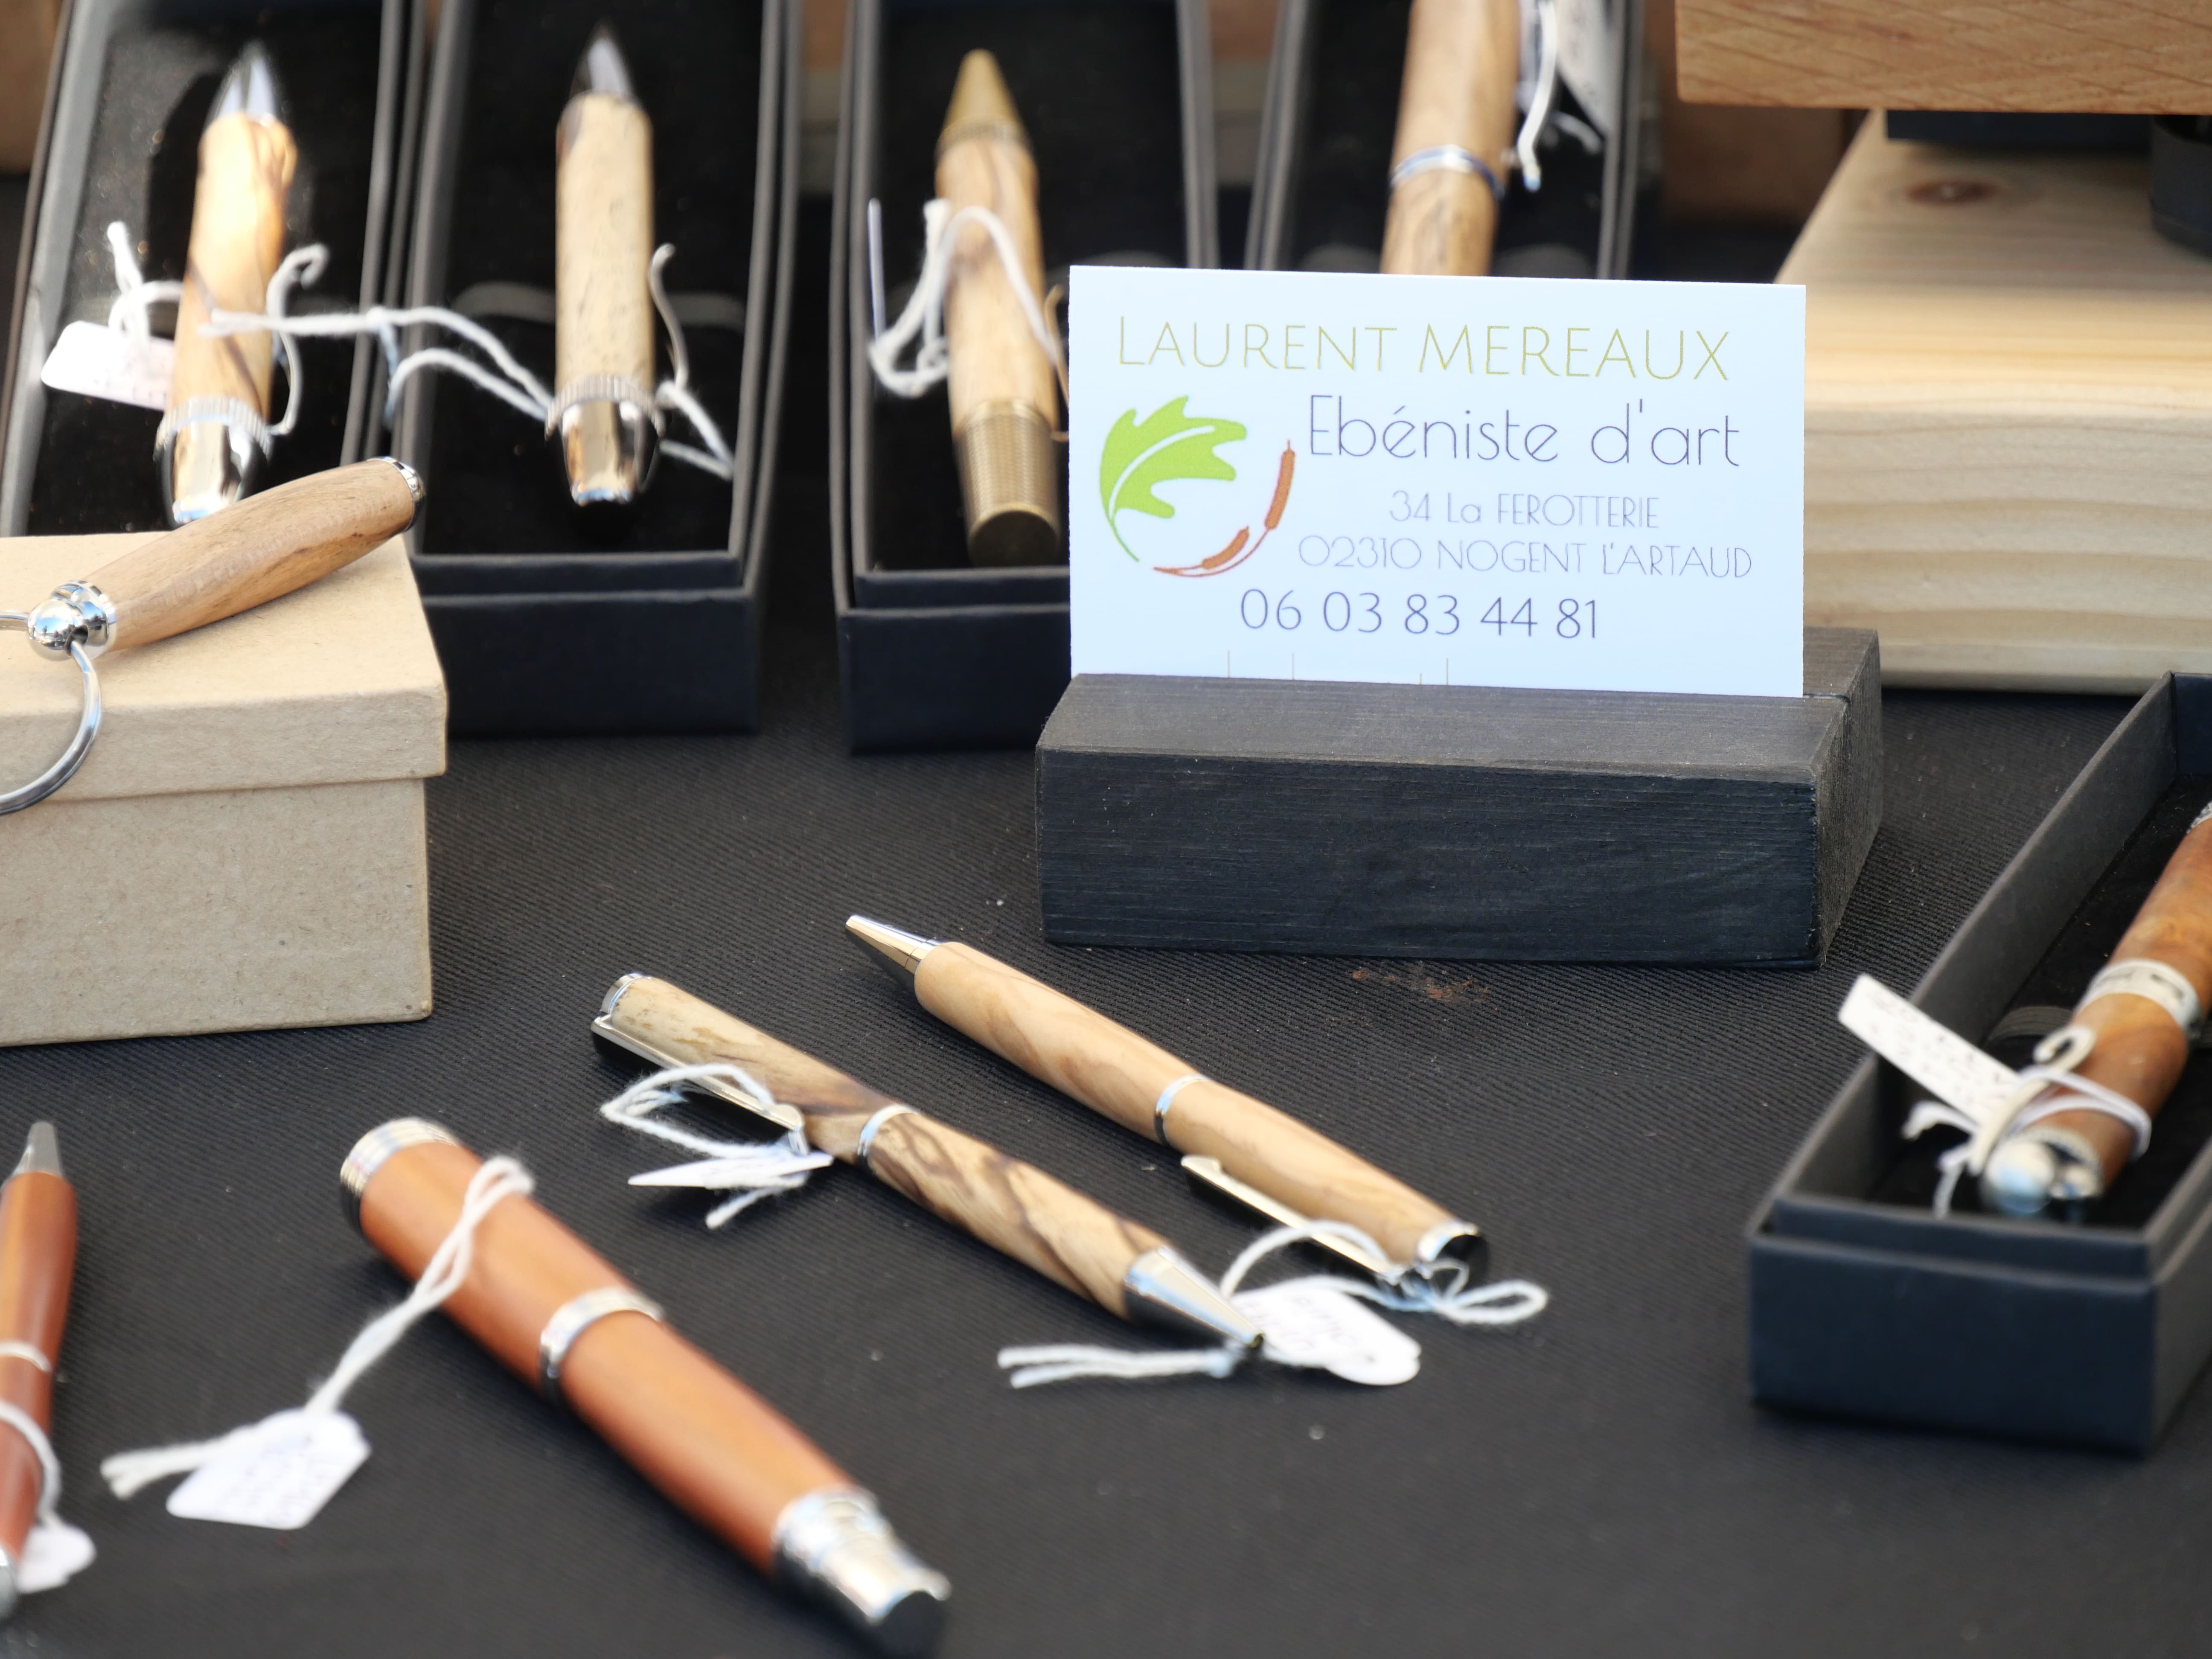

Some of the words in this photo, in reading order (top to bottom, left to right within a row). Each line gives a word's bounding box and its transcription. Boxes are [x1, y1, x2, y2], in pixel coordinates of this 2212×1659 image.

[1118, 316, 1397, 372] LAURENT
[1417, 323, 1729, 381] MEREAUX
[1310, 394, 1558, 463] Ebéniste
[1590, 398, 1740, 467] d'art
[1389, 490, 1432, 522] 34
[1447, 492, 1481, 524] La
[1498, 493, 1659, 528] FEROTTERIE
[1299, 535, 1422, 569] 02310
[1438, 540, 1586, 573] NOGENT
[1603, 542, 1752, 578] L'ARTAUD
[1240, 588, 1302, 631] 06
[1323, 591, 1382, 634] 03
[1404, 594, 1460, 636] 83
[1480, 597, 1538, 637] 44
[1556, 598, 1595, 639] 81
